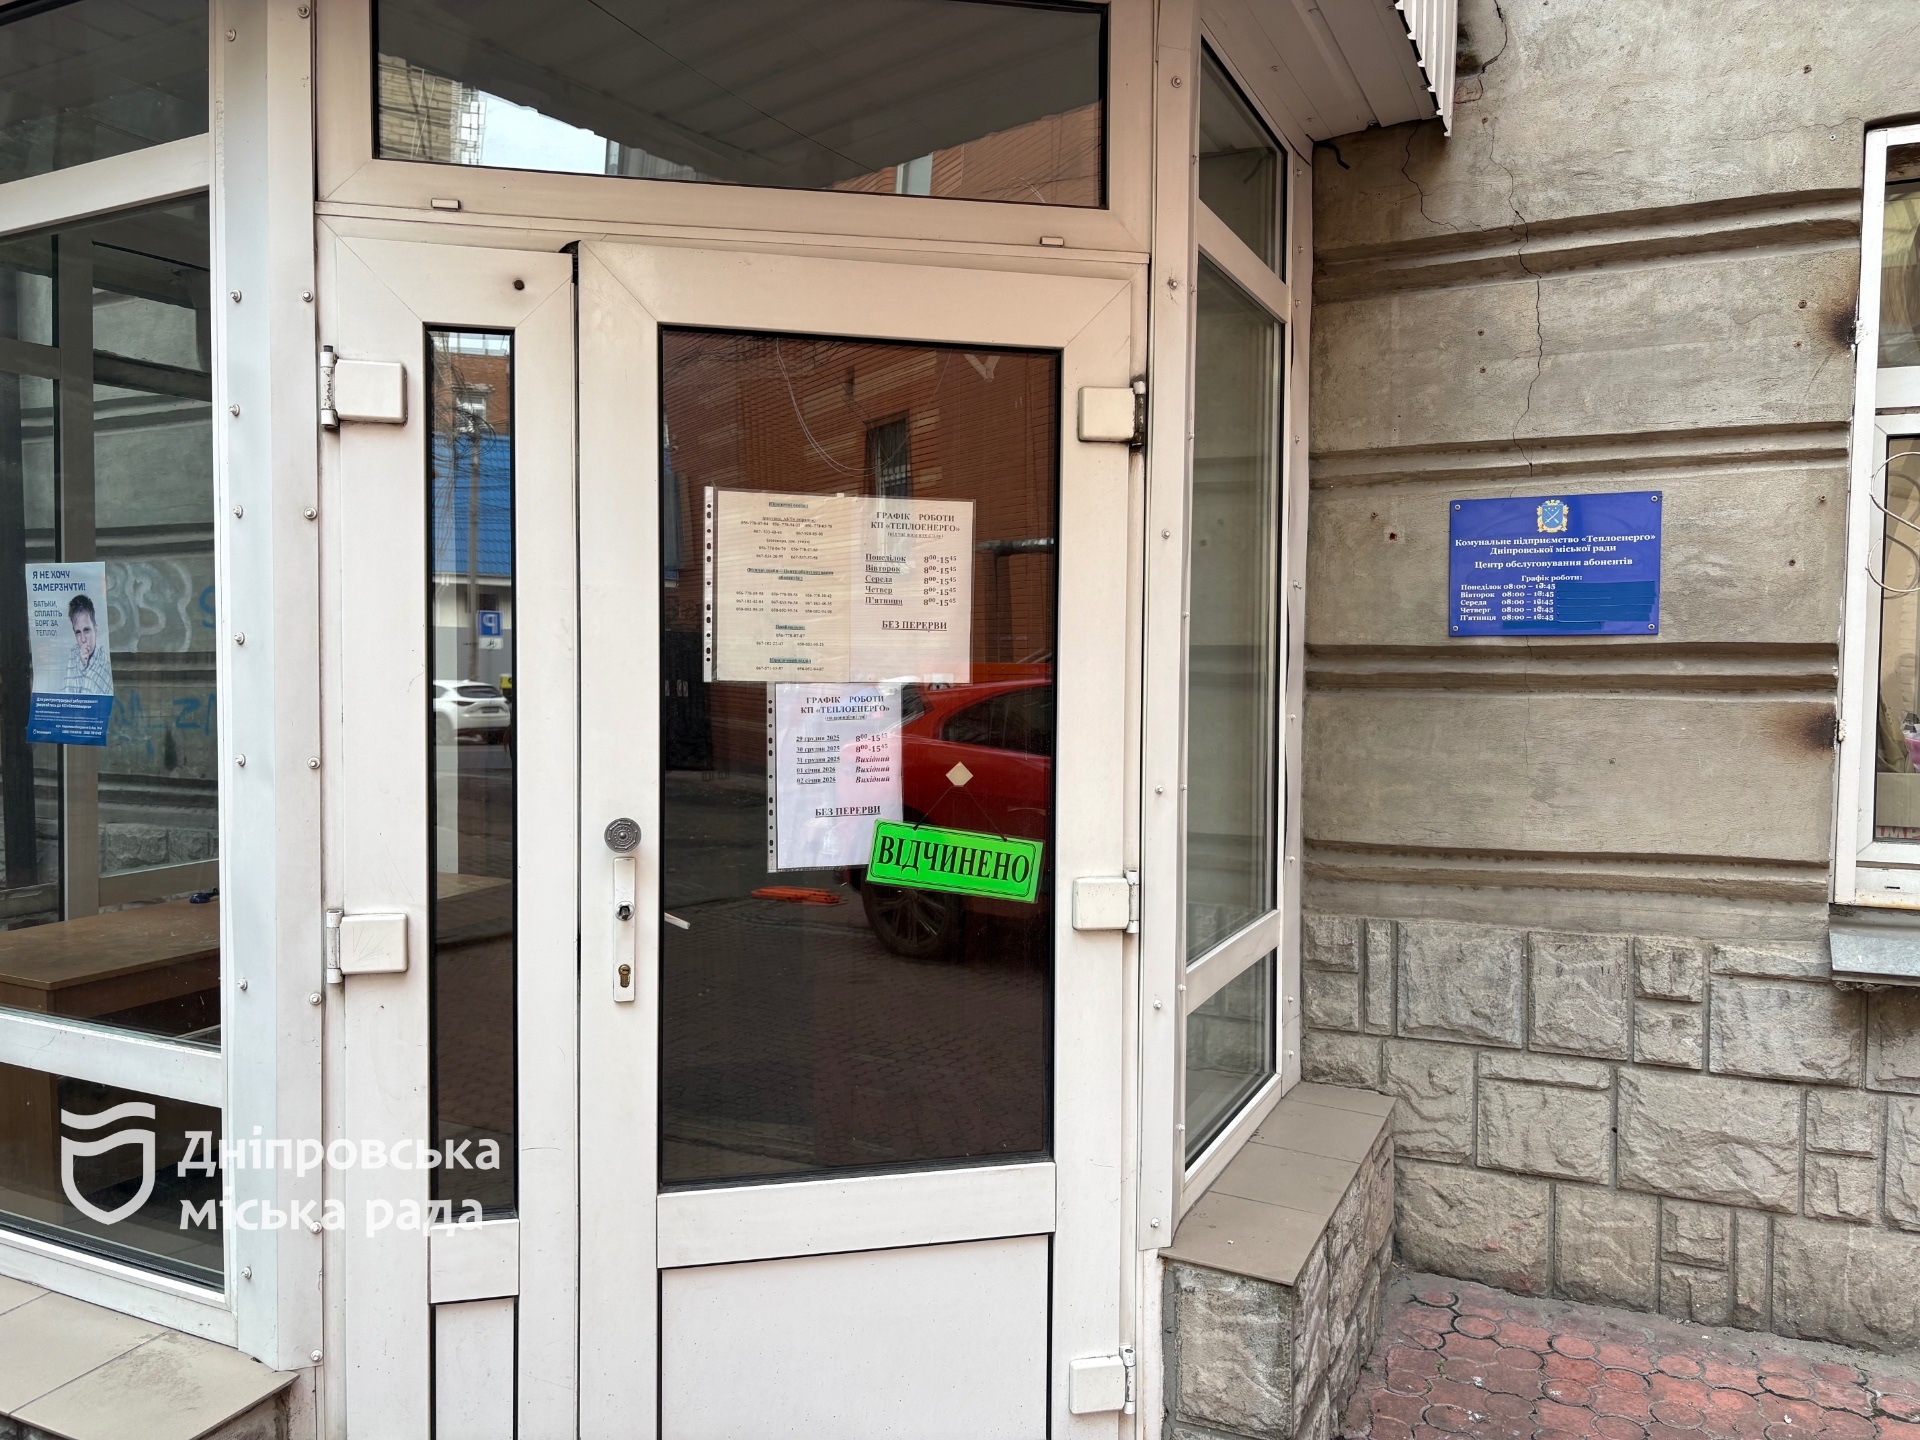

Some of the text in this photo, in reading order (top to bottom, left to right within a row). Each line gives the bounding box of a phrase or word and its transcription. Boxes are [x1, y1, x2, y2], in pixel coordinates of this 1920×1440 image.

[876, 511, 955, 522] ГРАФІК РОБОТИ
[870, 521, 960, 532] КП «ТЕПЛОЕНЕРГО»
[1455, 534, 1656, 547] Комунальне підприємство «Теплоенерго»
[1489, 544, 1617, 556] Дніпровської міської ради
[865, 554, 906, 562] Понеділок
[1474, 557, 1633, 570] Центр обслуговування абонентів
[865, 564, 901, 573] Вівторок
[32, 570, 70, 579] Я НЕ ХОЧУ
[864, 575, 892, 583] Середа
[1521, 574, 1583, 582] Графік роботи:
[32, 583, 86, 591] ЗАМЕРЗНУТИ!
[865, 586, 892, 594] Четвер
[882, 620, 947, 630] БЕЗ ПЕРЕРВИ
[806, 696, 841, 704] ГРАФІК
[800, 705, 890, 714] КП «ТЕПЛОЕНЕРГО»
[855, 756, 890, 764] Вихідний
[856, 776, 890, 784] Вихідний
[815, 806, 881, 816] БЕЗ ПЕРЕРВИ
[878, 835, 1030, 884] ВІДЧИНЕНО
